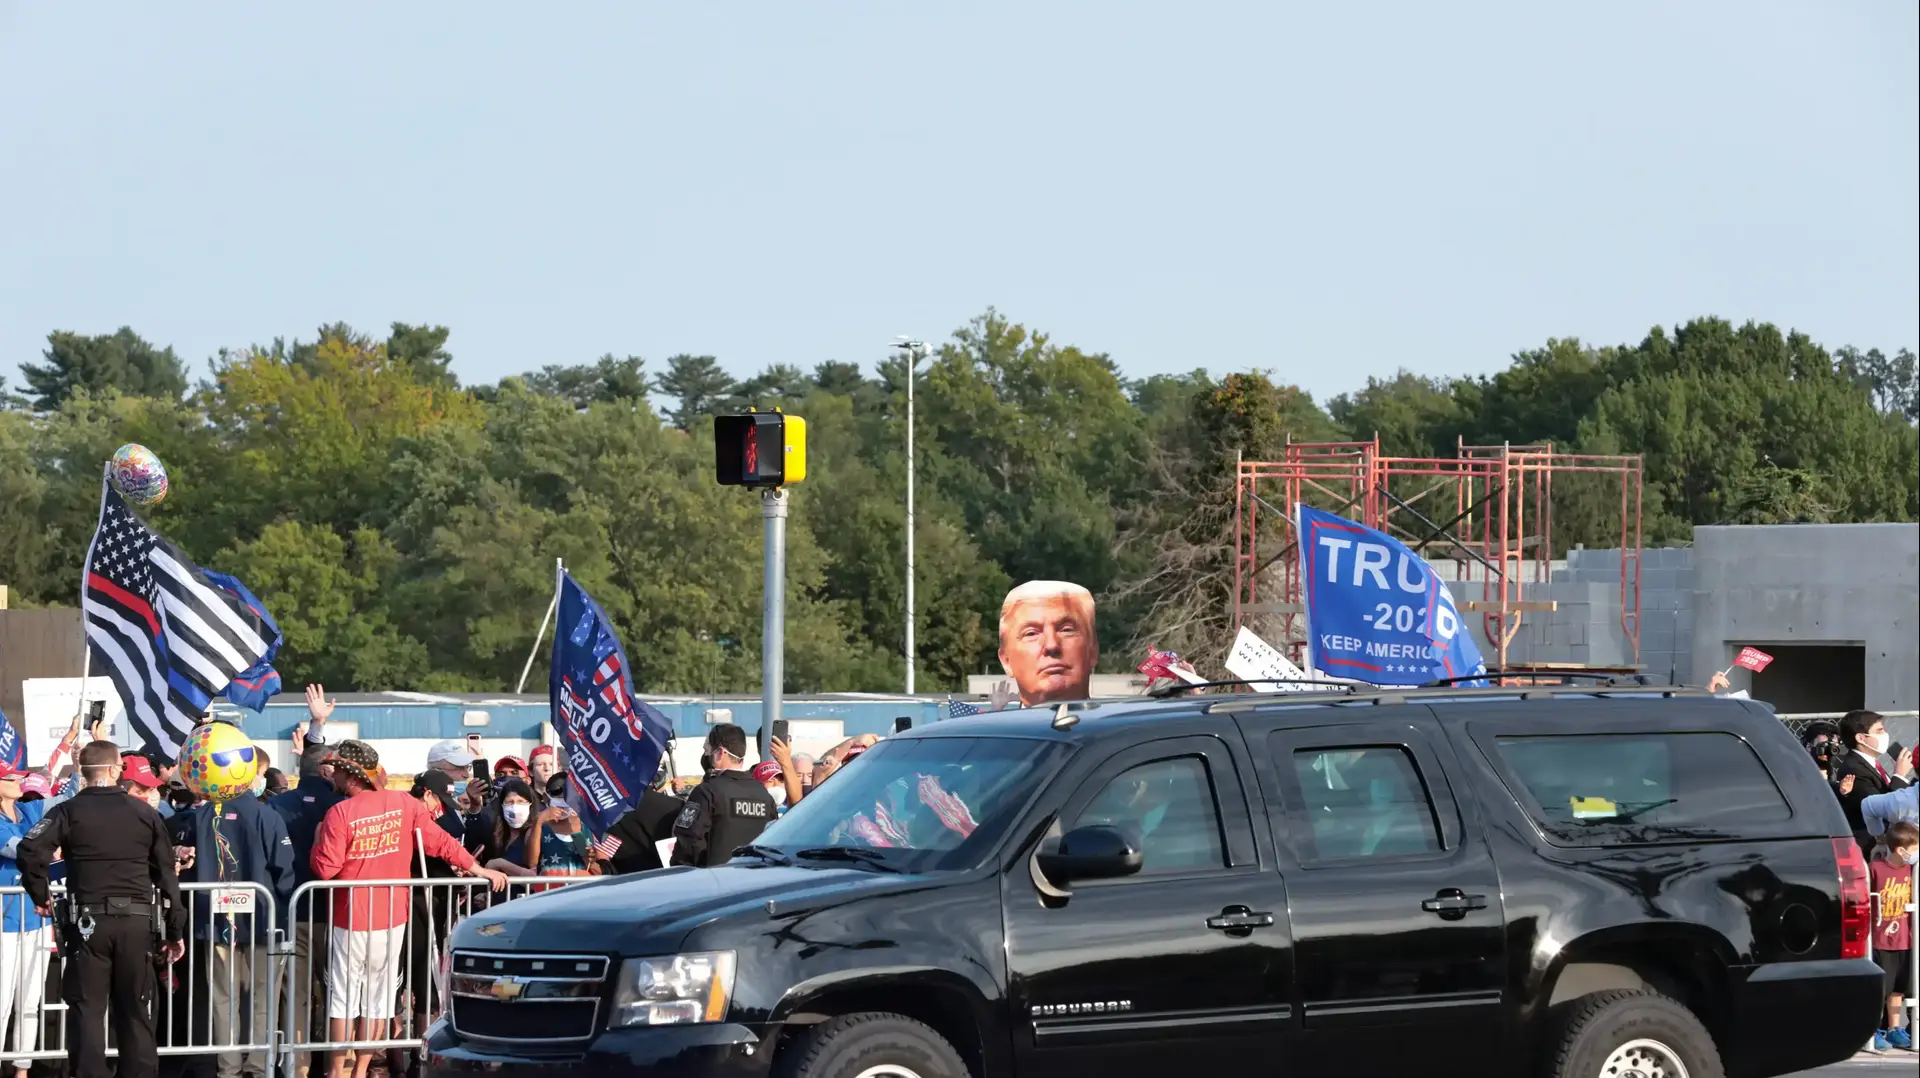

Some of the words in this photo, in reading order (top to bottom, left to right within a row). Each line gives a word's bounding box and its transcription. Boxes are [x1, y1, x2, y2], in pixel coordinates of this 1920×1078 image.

[1319, 536, 1426, 594] TRU
[1259, 643, 1282, 662] GET
[1320, 633, 1362, 651] KEEP
[1365, 643, 1432, 660] AMERIC
[584, 771, 618, 810] AGAIN
[735, 800, 766, 817] POLICE
[383, 818, 402, 831] ON
[351, 837, 378, 852] THE
[379, 830, 400, 848] PIG
[1031, 1000, 1131, 1016] SUBURBAN
